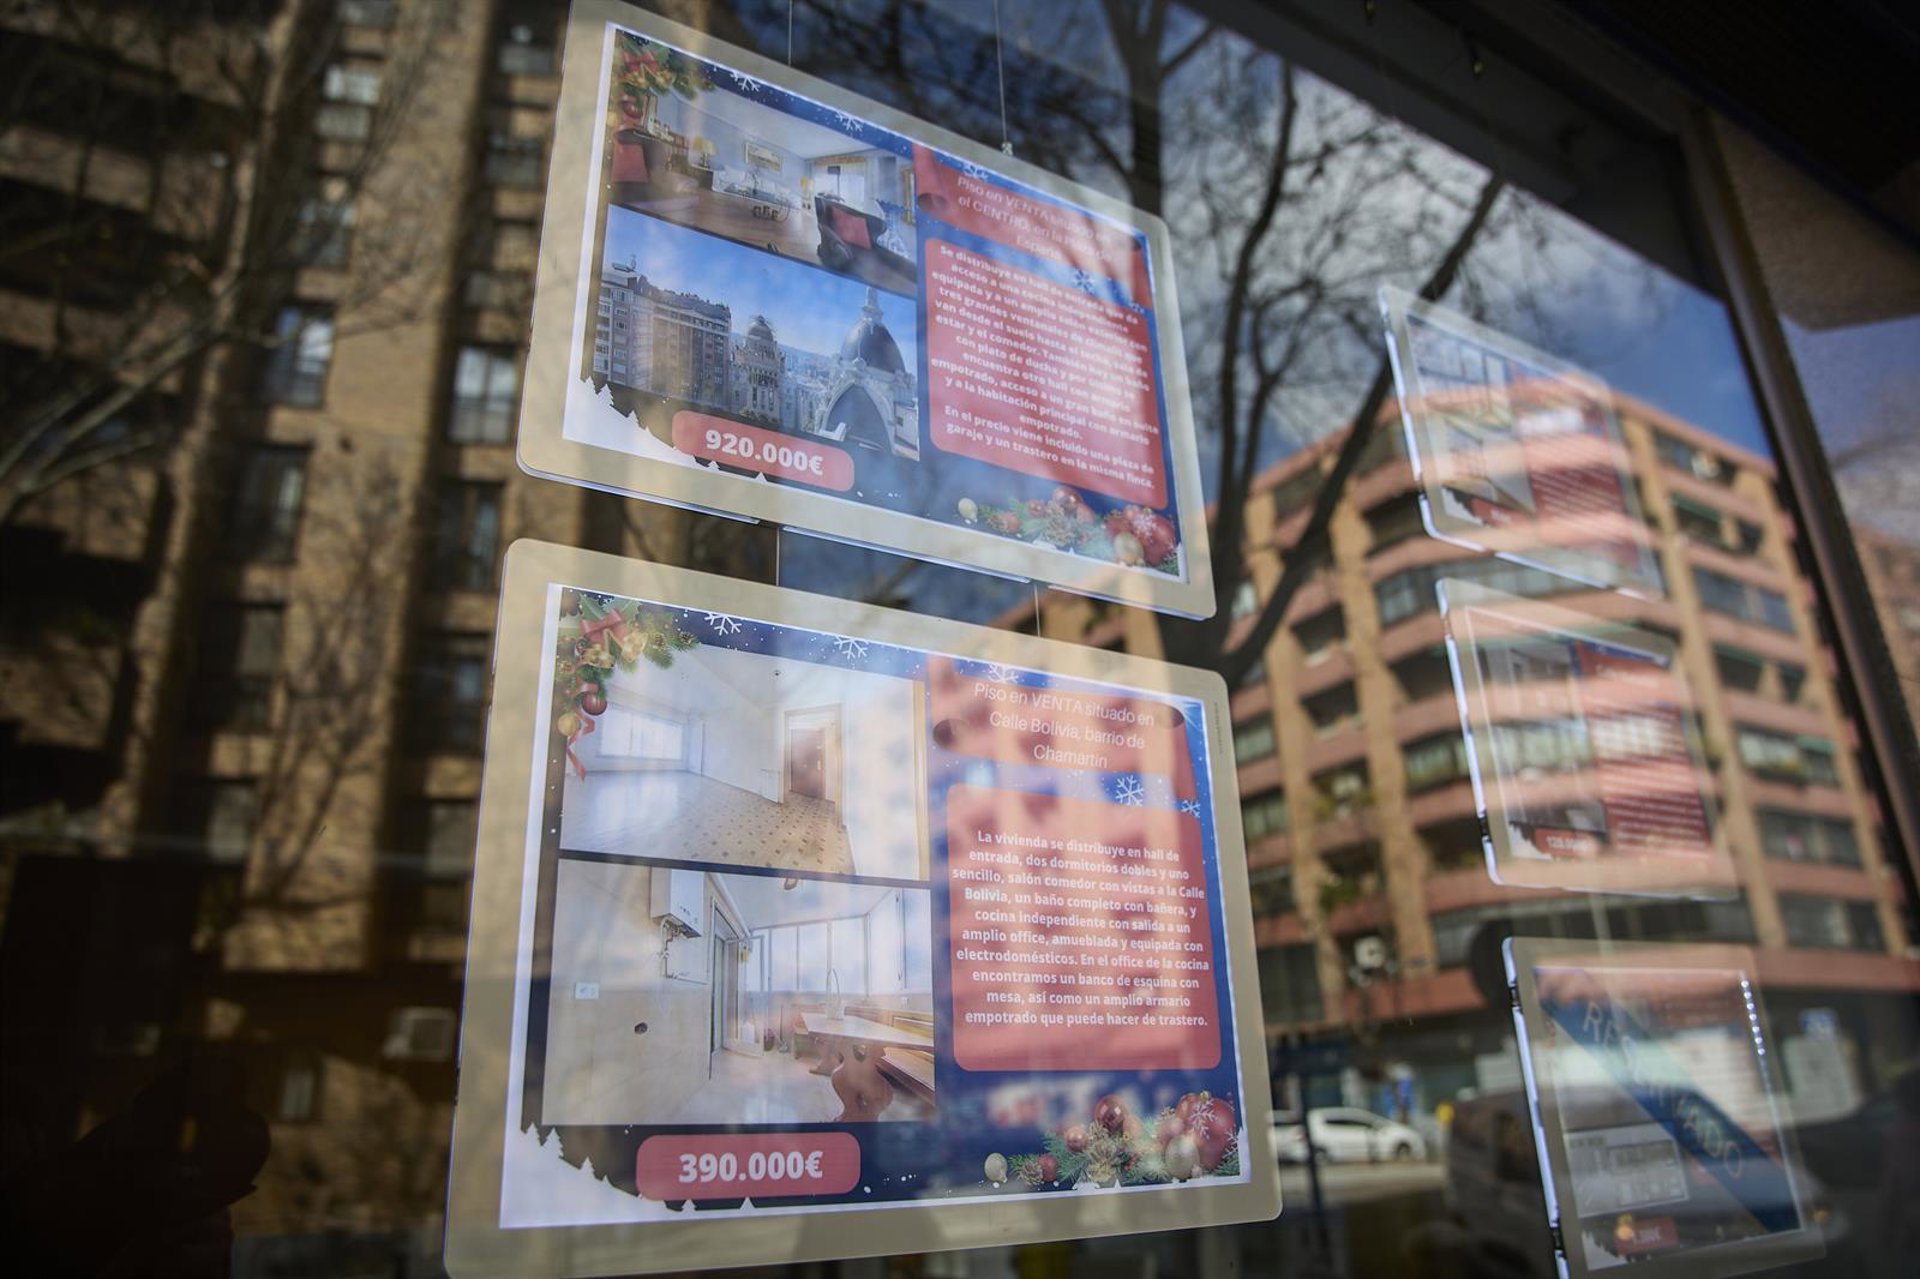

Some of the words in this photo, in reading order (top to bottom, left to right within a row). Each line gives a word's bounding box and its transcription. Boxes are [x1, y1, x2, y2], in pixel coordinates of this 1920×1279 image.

[951, 265, 987, 284] acceso
[990, 279, 996, 287] a
[999, 282, 1018, 294] una
[956, 251, 1011, 280] distribuye
[932, 269, 982, 296] equipada
[985, 289, 991, 300] y
[994, 293, 1000, 301] a
[1004, 296, 1018, 307] un
[1020, 300, 1056, 322] amplio
[939, 286, 961, 301] tres
[964, 294, 1007, 319] grandes
[935, 301, 956, 314] van
[959, 306, 990, 325] desde
[993, 318, 1003, 329] el
[1006, 322, 1034, 340] suelo
[936, 314, 965, 331] estar
[968, 326, 974, 336] y
[976, 326, 986, 338] el
[989, 331, 1040, 355] comedor.
[956, 336, 975, 349] con
[978, 341, 1006, 361] plato
[1009, 351, 1022, 364] de
[1025, 356, 1057, 375] ducha
[1059, 370, 1066, 380] y
[962, 351, 1019, 377] encuentra
[1022, 370, 1045, 385] otro
[931, 356, 997, 387] empotrado,
[1001, 380, 1037, 397] acceso
[1040, 392, 1047, 400] a
[1050, 395, 1063, 405] un
[1065, 399, 1089, 415] gran
[944, 377, 951, 388] y
[955, 380, 961, 389] a
[965, 381, 974, 393] la
[977, 385, 1036, 411] habitación
[1039, 404, 1086, 428] principal
[945, 406, 958, 419] En
[961, 410, 971, 422] el
[974, 415, 1009, 435] precio
[1012, 426, 1041, 442] viene
[1090, 449, 1109, 461] una
[1140, 461, 1154, 473] de
[1019, 413, 1082, 441] empotrado.
[706, 429, 824, 476] 920.000€
[946, 424, 982, 443] garaje
[985, 435, 992, 446] y
[995, 438, 1009, 448] un
[1012, 441, 1057, 461] trastero
[1060, 456, 1073, 466] en
[1076, 458, 1086, 469] la
[1089, 462, 1123, 479] misma
[975, 683, 1006, 701] Piso
[1010, 692, 1027, 704] en
[1032, 694, 1083, 713] VENTA
[1086, 702, 1135, 723] situado
[1138, 713, 1154, 727] en
[990, 711, 1027, 730] Calle
[1085, 725, 1124, 746] barrio
[1127, 734, 1145, 749] de
[977, 830, 991, 843] La
[995, 832, 1047, 848] vivienda
[1050, 840, 1064, 850] se
[1066, 839, 1125, 858] distribuye
[1127, 848, 1140, 857] en
[1143, 847, 1163, 859] hall
[1166, 849, 1179, 861] de
[969, 848, 1022, 866] entrada,
[1026, 854, 1046, 867] dos
[1049, 856, 1118, 873] dormitorios
[1120, 862, 1156, 876] dobles
[1158, 869, 1165, 880] y
[1169, 870, 1189, 879] uno
[952, 866, 1004, 884] sencillo,
[1008, 871, 1041, 885] salón
[1044, 874, 1096, 890] comedor
[1099, 882, 1118, 891] con
[1121, 881, 1155, 894] vistas
[1157, 886, 1163, 895] a
[1166, 884, 1176, 896] la
[1178, 885, 1204, 898] Calle
[964, 887, 1011, 904] Bolivia,
[1015, 894, 1031, 904] un
[1034, 892, 1063, 906] baño
[1066, 895, 1121, 912] completo
[1124, 902, 1143, 911] con
[1146, 901, 1187, 916] bañera,
[1189, 907, 1197, 918] y
[975, 908, 1014, 922] cocina
[1019, 910, 1105, 930] independiente
[1108, 919, 1128, 929] con
[1131, 918, 1164, 931] salida
[1167, 923, 1173, 932] a
[1176, 924, 1190, 932] un
[961, 927, 1006, 944] amplio
[1010, 930, 1048, 945] office,
[1052, 932, 1117, 947] amueblada
[1119, 939, 1128, 950] y
[1130, 936, 1181, 953] equipada
[1184, 942, 1203, 951] con
[956, 947, 1077, 964] electrodomésticos.
[1080, 953, 1094, 965] En
[1097, 954, 1108, 966] el
[1111, 954, 1143, 967] office
[1146, 956, 1159, 968] de
[1162, 957, 1172, 968] la
[1174, 958, 1209, 970] cocina
[972, 969, 1056, 983] encontramos
[1060, 974, 1075, 984] un
[1078, 972, 1112, 985] banco
[1116, 974, 1130, 985] de
[1133, 975, 1177, 990] esquina
[1180, 979, 1199, 988] con
[986, 992, 1024, 1004] mesa,
[1028, 991, 1046, 1003] así
[1049, 994, 1082, 1004] como
[1085, 995, 1100, 1004] un
[1103, 992, 1142, 1008] amplio
[1145, 994, 1190, 1006] armario
[965, 1009, 1037, 1026] empotrado
[1040, 1014, 1063, 1026] que
[1066, 1011, 1104, 1027] puede
[1106, 1012, 1138, 1024] hacer
[1142, 1013, 1155, 1024] de
[1158, 1014, 1207, 1025] trastero.
[678, 1150, 823, 1183] 390.000€
